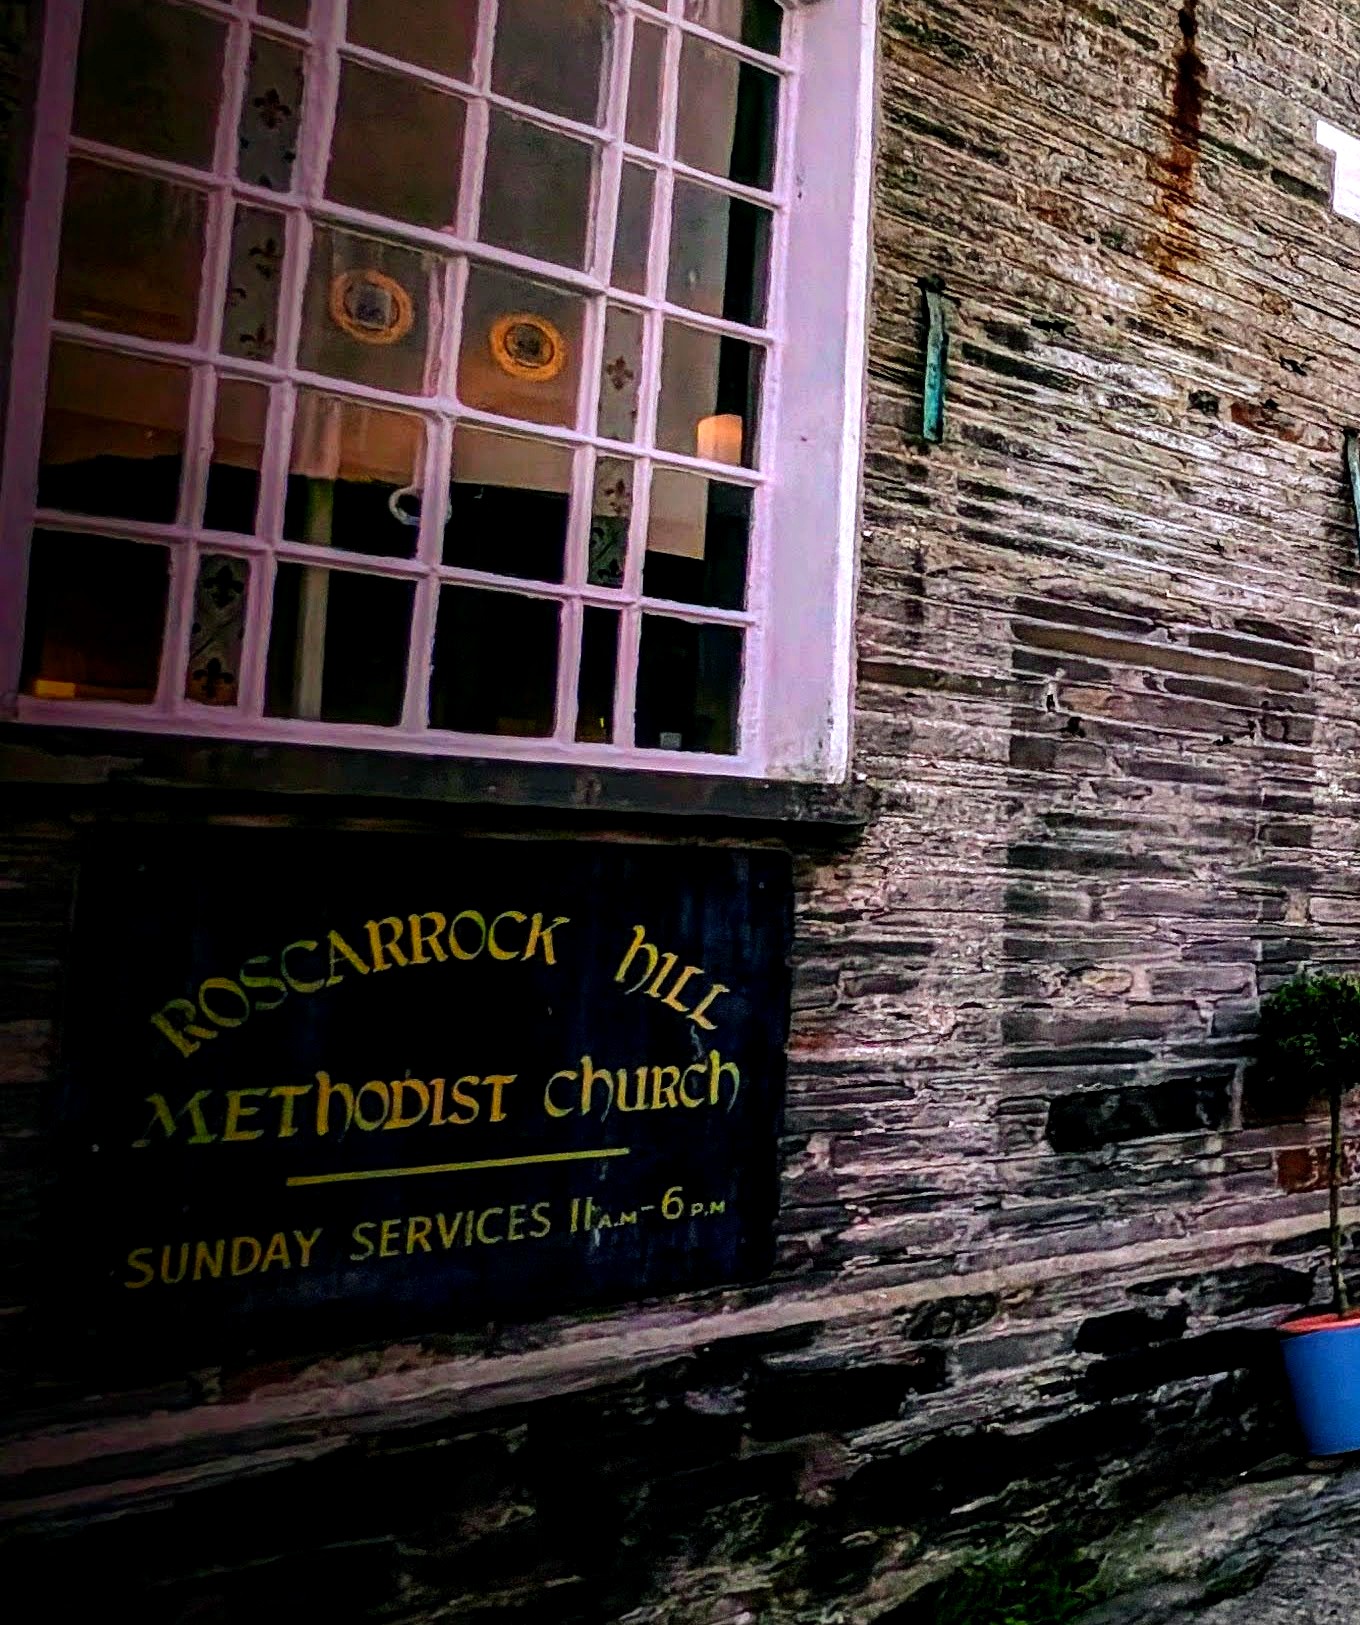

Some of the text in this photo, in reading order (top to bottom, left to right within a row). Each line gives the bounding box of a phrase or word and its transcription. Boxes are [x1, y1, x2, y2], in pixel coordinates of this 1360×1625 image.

[150, 909, 571, 1058] ROSCARROCK
[125, 1228, 323, 1289] SUNDAY
[350, 1201, 552, 1262] SERVICES
